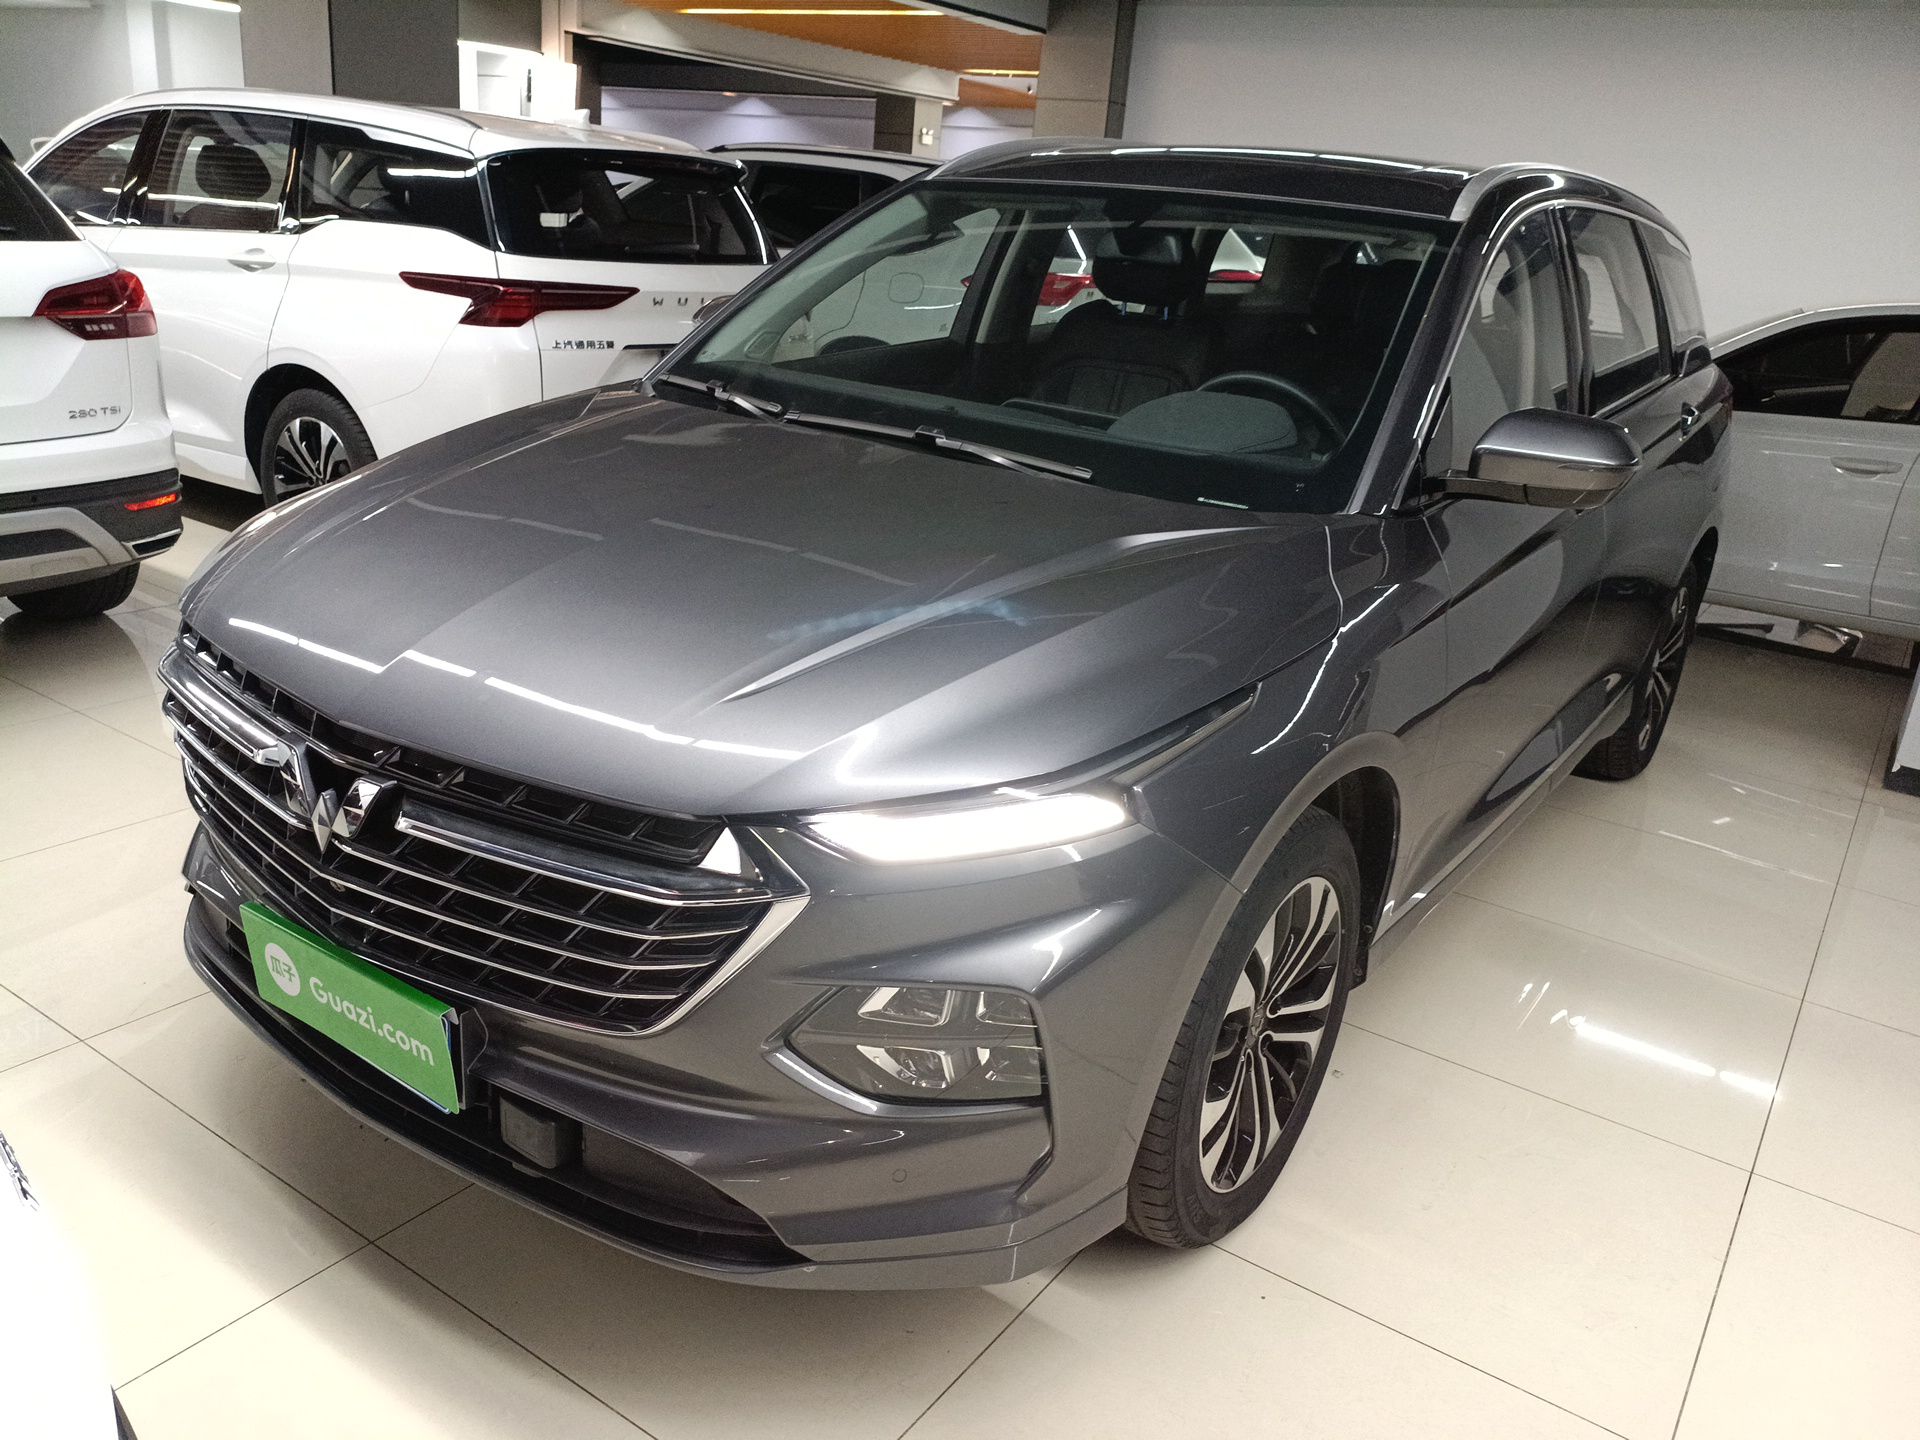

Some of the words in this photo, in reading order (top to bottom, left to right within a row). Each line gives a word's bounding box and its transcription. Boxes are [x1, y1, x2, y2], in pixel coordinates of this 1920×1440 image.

[69, 408, 97, 419] 280
[270, 954, 296, 983] 瓜子
[309, 976, 435, 1067] Guazi.com
